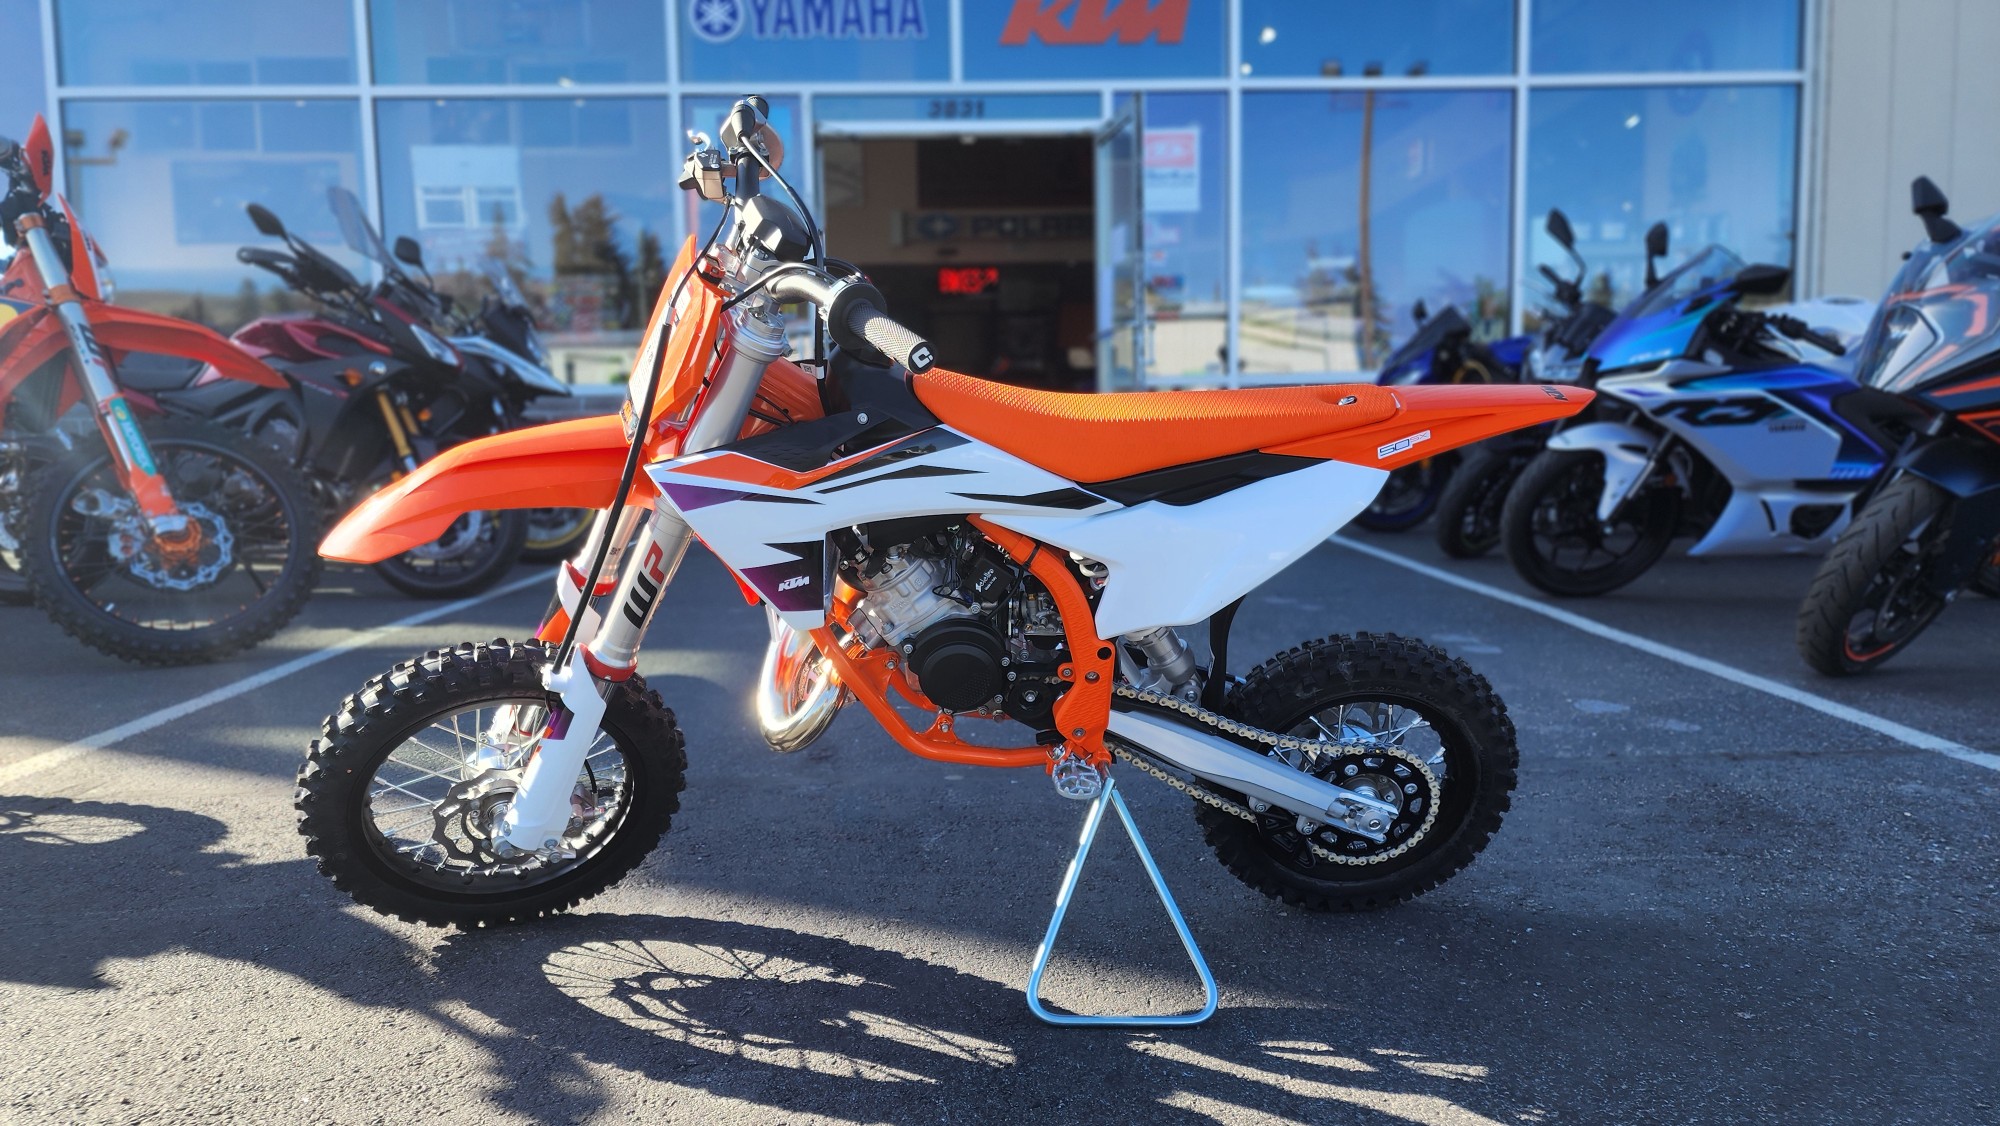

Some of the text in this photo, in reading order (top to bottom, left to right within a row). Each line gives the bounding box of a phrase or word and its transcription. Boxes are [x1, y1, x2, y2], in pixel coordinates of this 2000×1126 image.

[752, 0, 926, 37] YAMAHA
[999, 0, 1190, 45] KTM
[623, 540, 665, 630] WP
[778, 576, 810, 592] KTM
